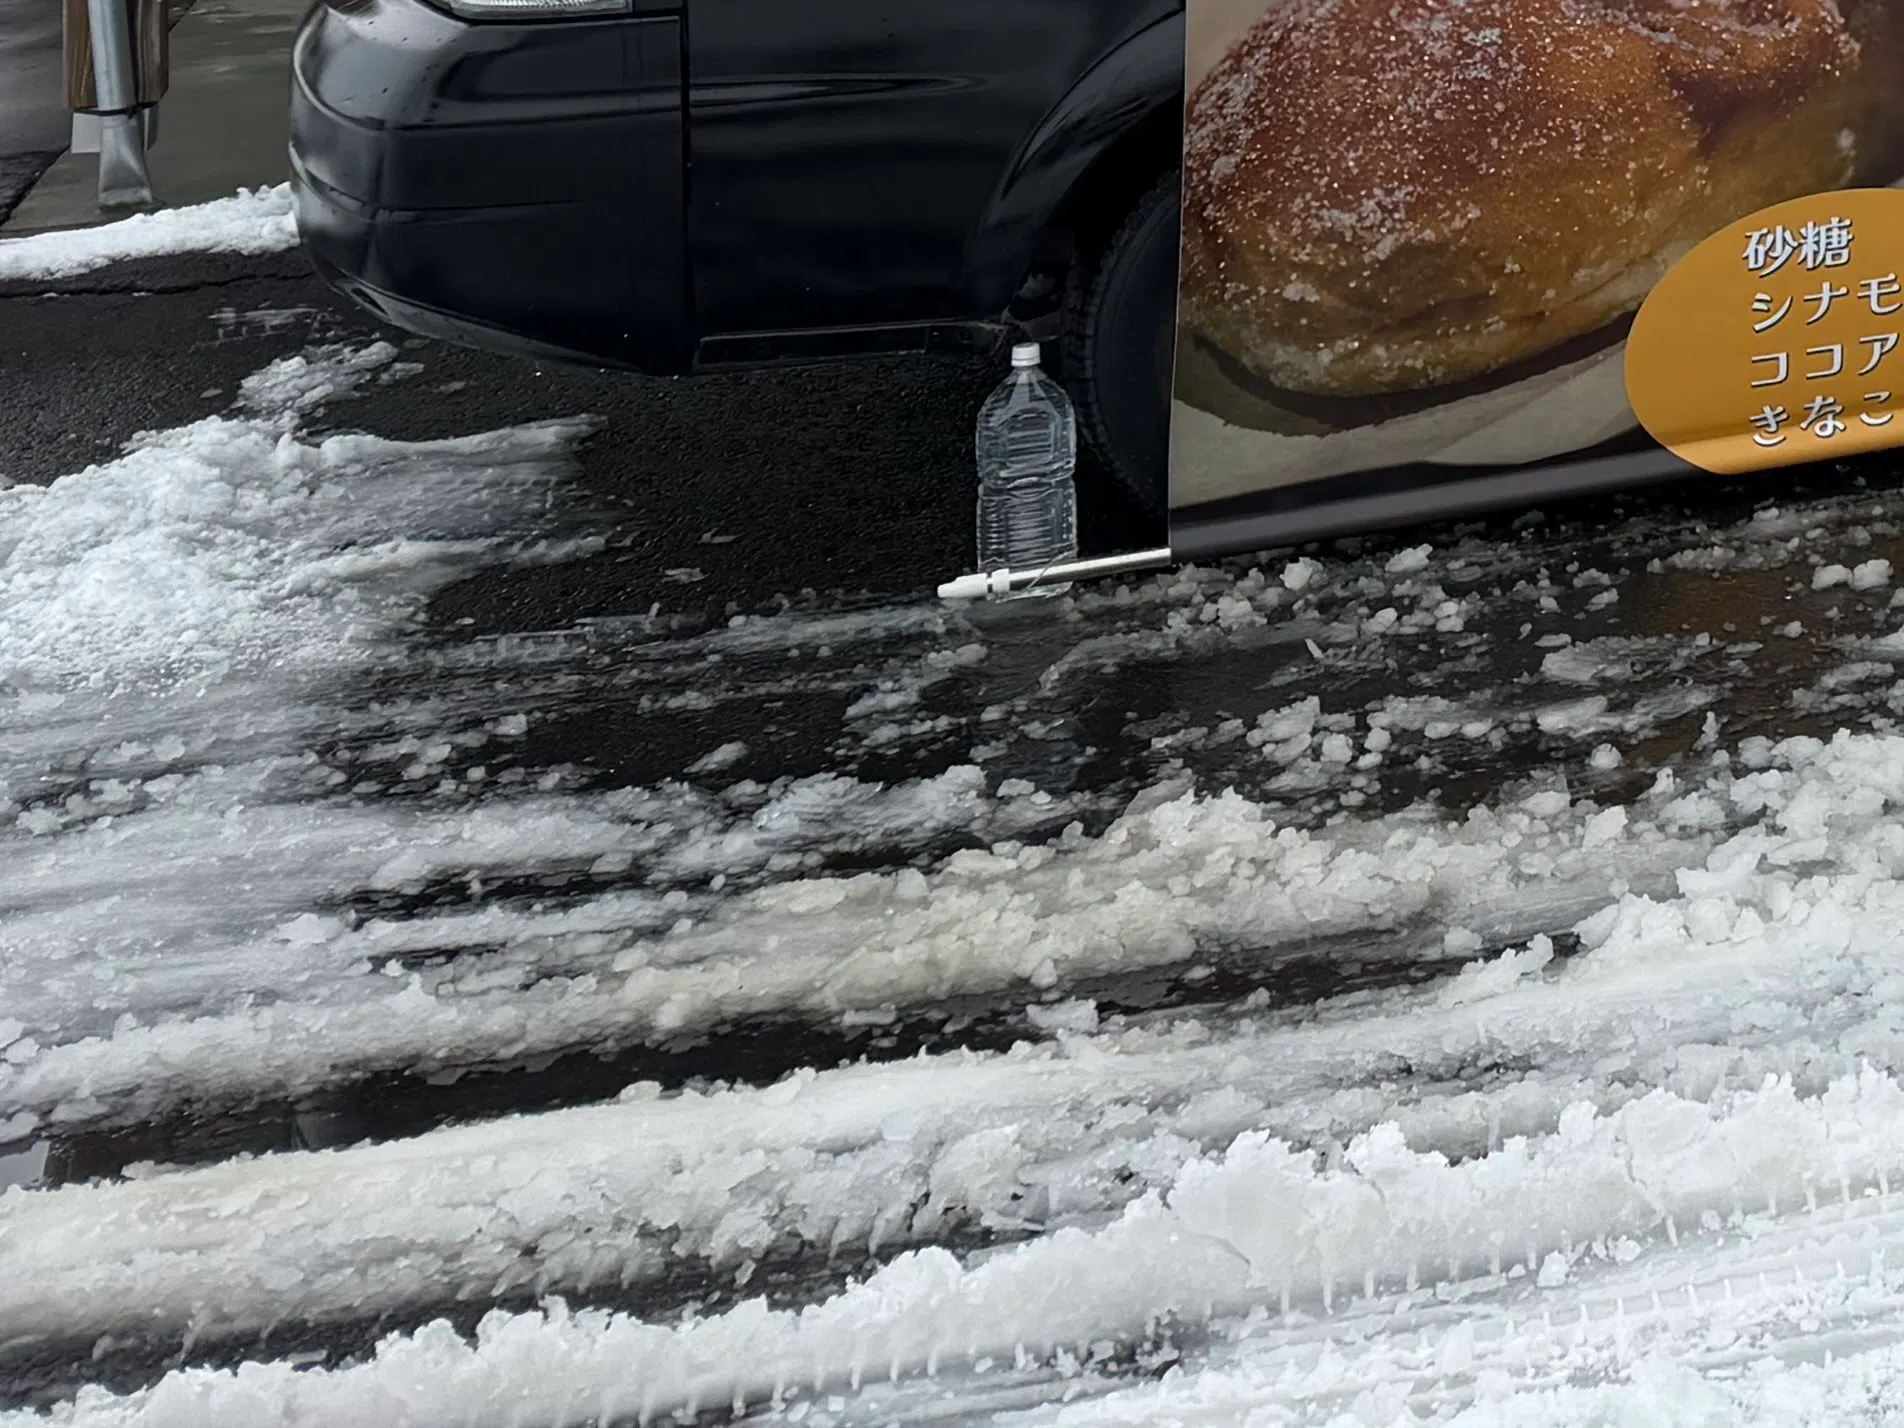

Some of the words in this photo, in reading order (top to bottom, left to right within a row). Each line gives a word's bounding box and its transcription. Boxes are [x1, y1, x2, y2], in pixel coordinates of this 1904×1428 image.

[1742, 216, 1855, 278] 砂糖
[1750, 332, 1900, 388] ココア
[1748, 390, 1894, 447] きなこ
